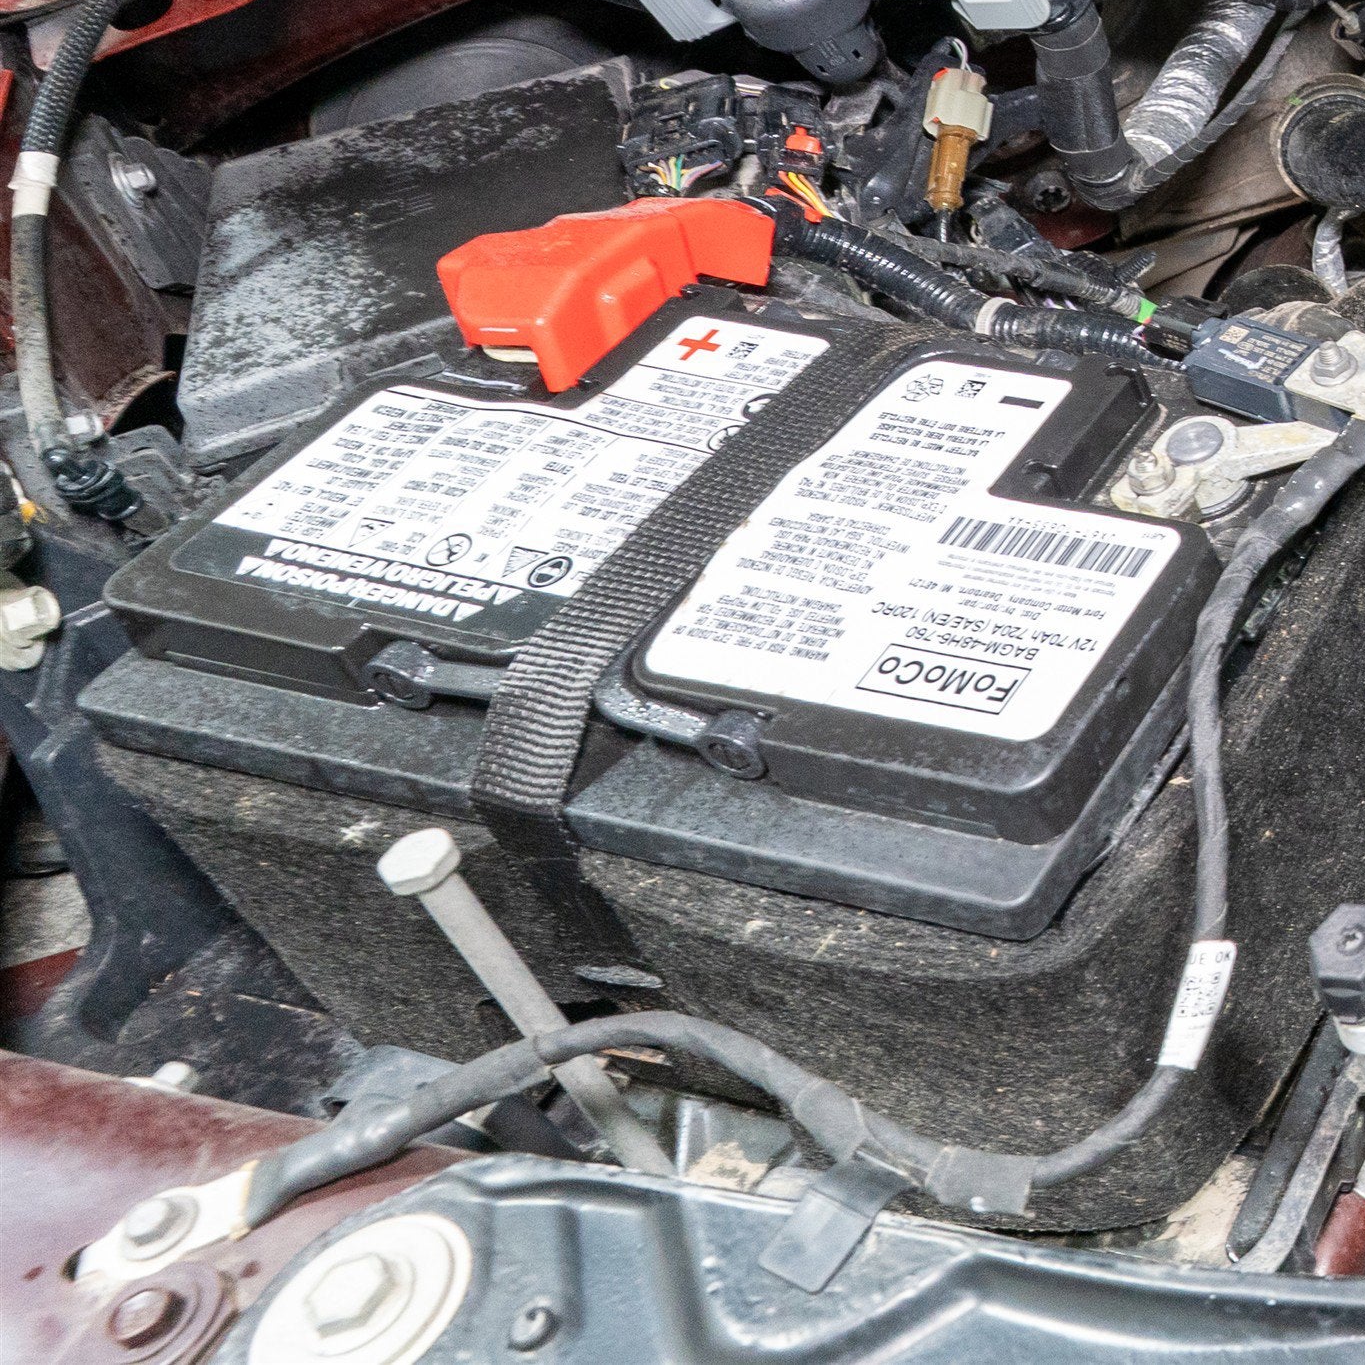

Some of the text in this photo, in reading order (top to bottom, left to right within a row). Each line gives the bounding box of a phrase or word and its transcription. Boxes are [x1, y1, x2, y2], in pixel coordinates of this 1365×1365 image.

[876, 422, 924, 435] RECICLARSE
[923, 430, 945, 439] DEBE
[956, 425, 994, 436] BATTERIE
[868, 432, 980, 456] BATTERY MUST BE RECYCLED
[277, 542, 501, 600] PELIGRO/VENENO
[251, 559, 461, 615] DANGER/POISON
[868, 601, 921, 620] 120RC
[1052, 603, 1083, 615] Motor
[1082, 608, 1106, 619] Ford
[989, 622, 1029, 639] 720A
[1027, 629, 1069, 646] 70Ah
[765, 642, 788, 653] RISK
[902, 625, 1040, 660] BAGM-48H6-760
[1068, 636, 1100, 652] 12V
[869, 655, 1019, 702] FoMoCo
[1214, 950, 1231, 963] OK
